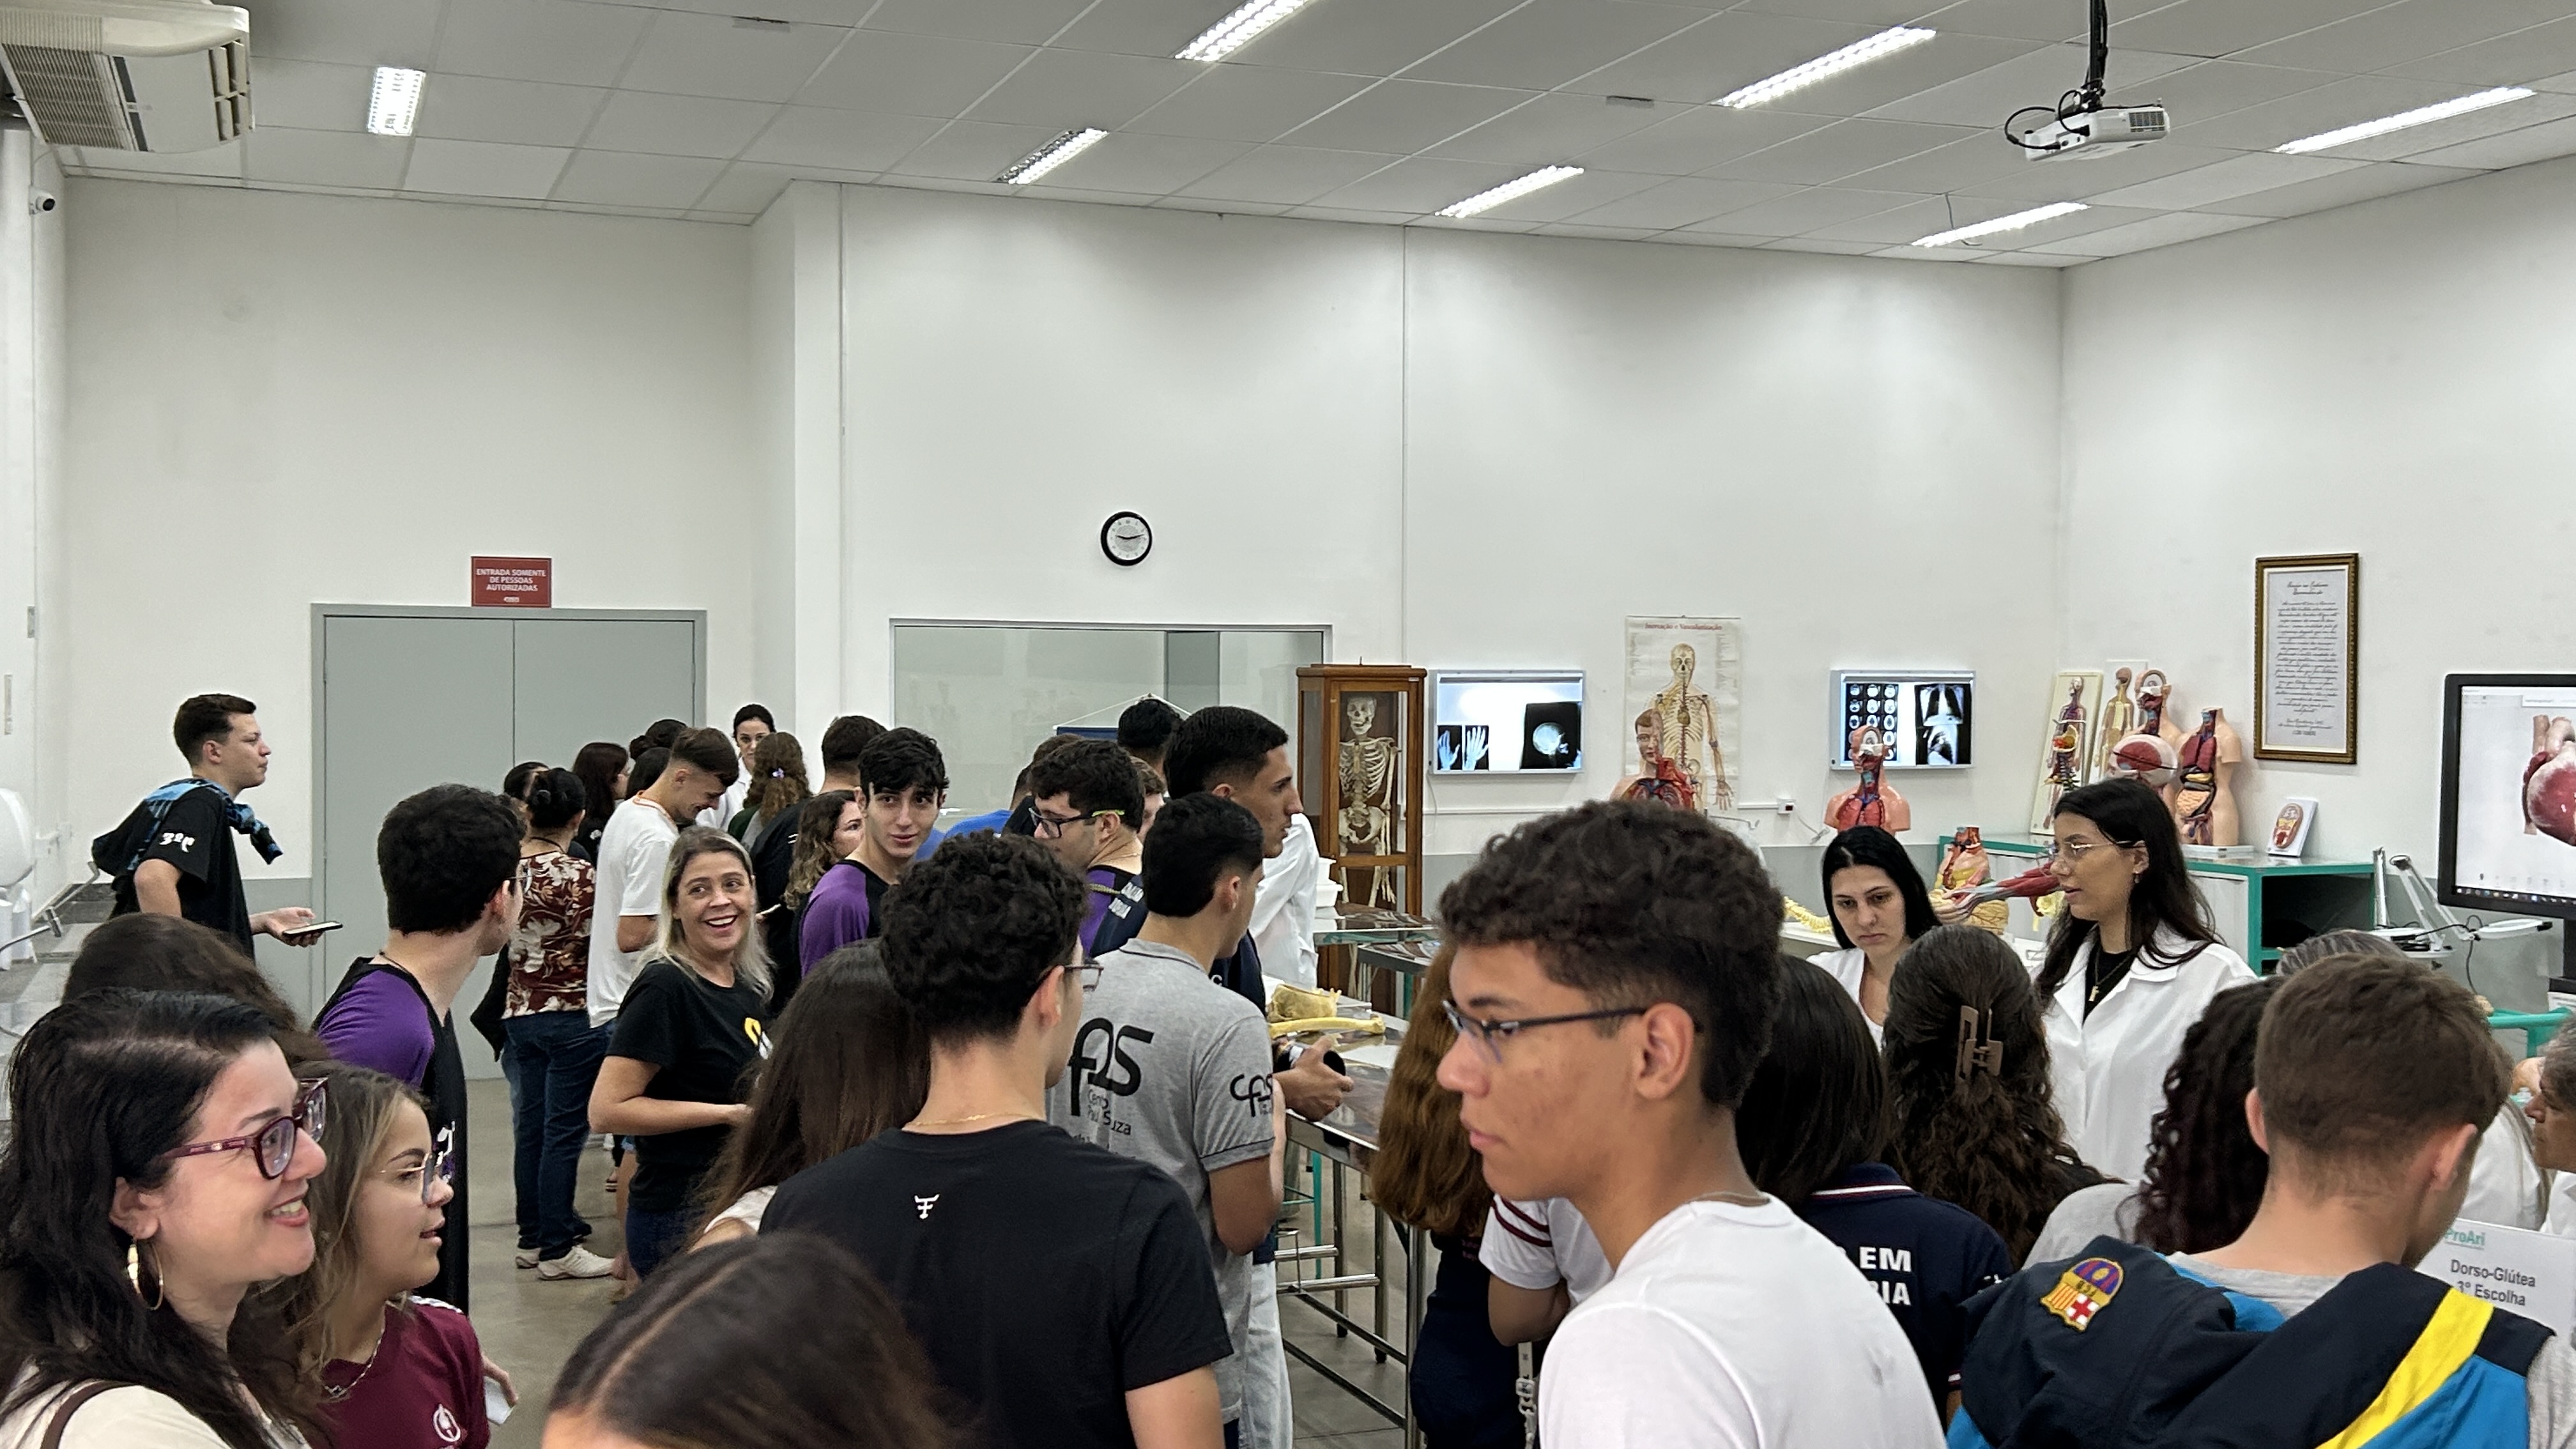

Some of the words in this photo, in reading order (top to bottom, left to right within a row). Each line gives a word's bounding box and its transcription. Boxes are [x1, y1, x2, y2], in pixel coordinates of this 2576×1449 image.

[1859, 1246, 1912, 1273] EM
[2451, 1259, 2536, 1287] Dorso-Glútea
[2474, 1284, 2526, 1306] Escolha
